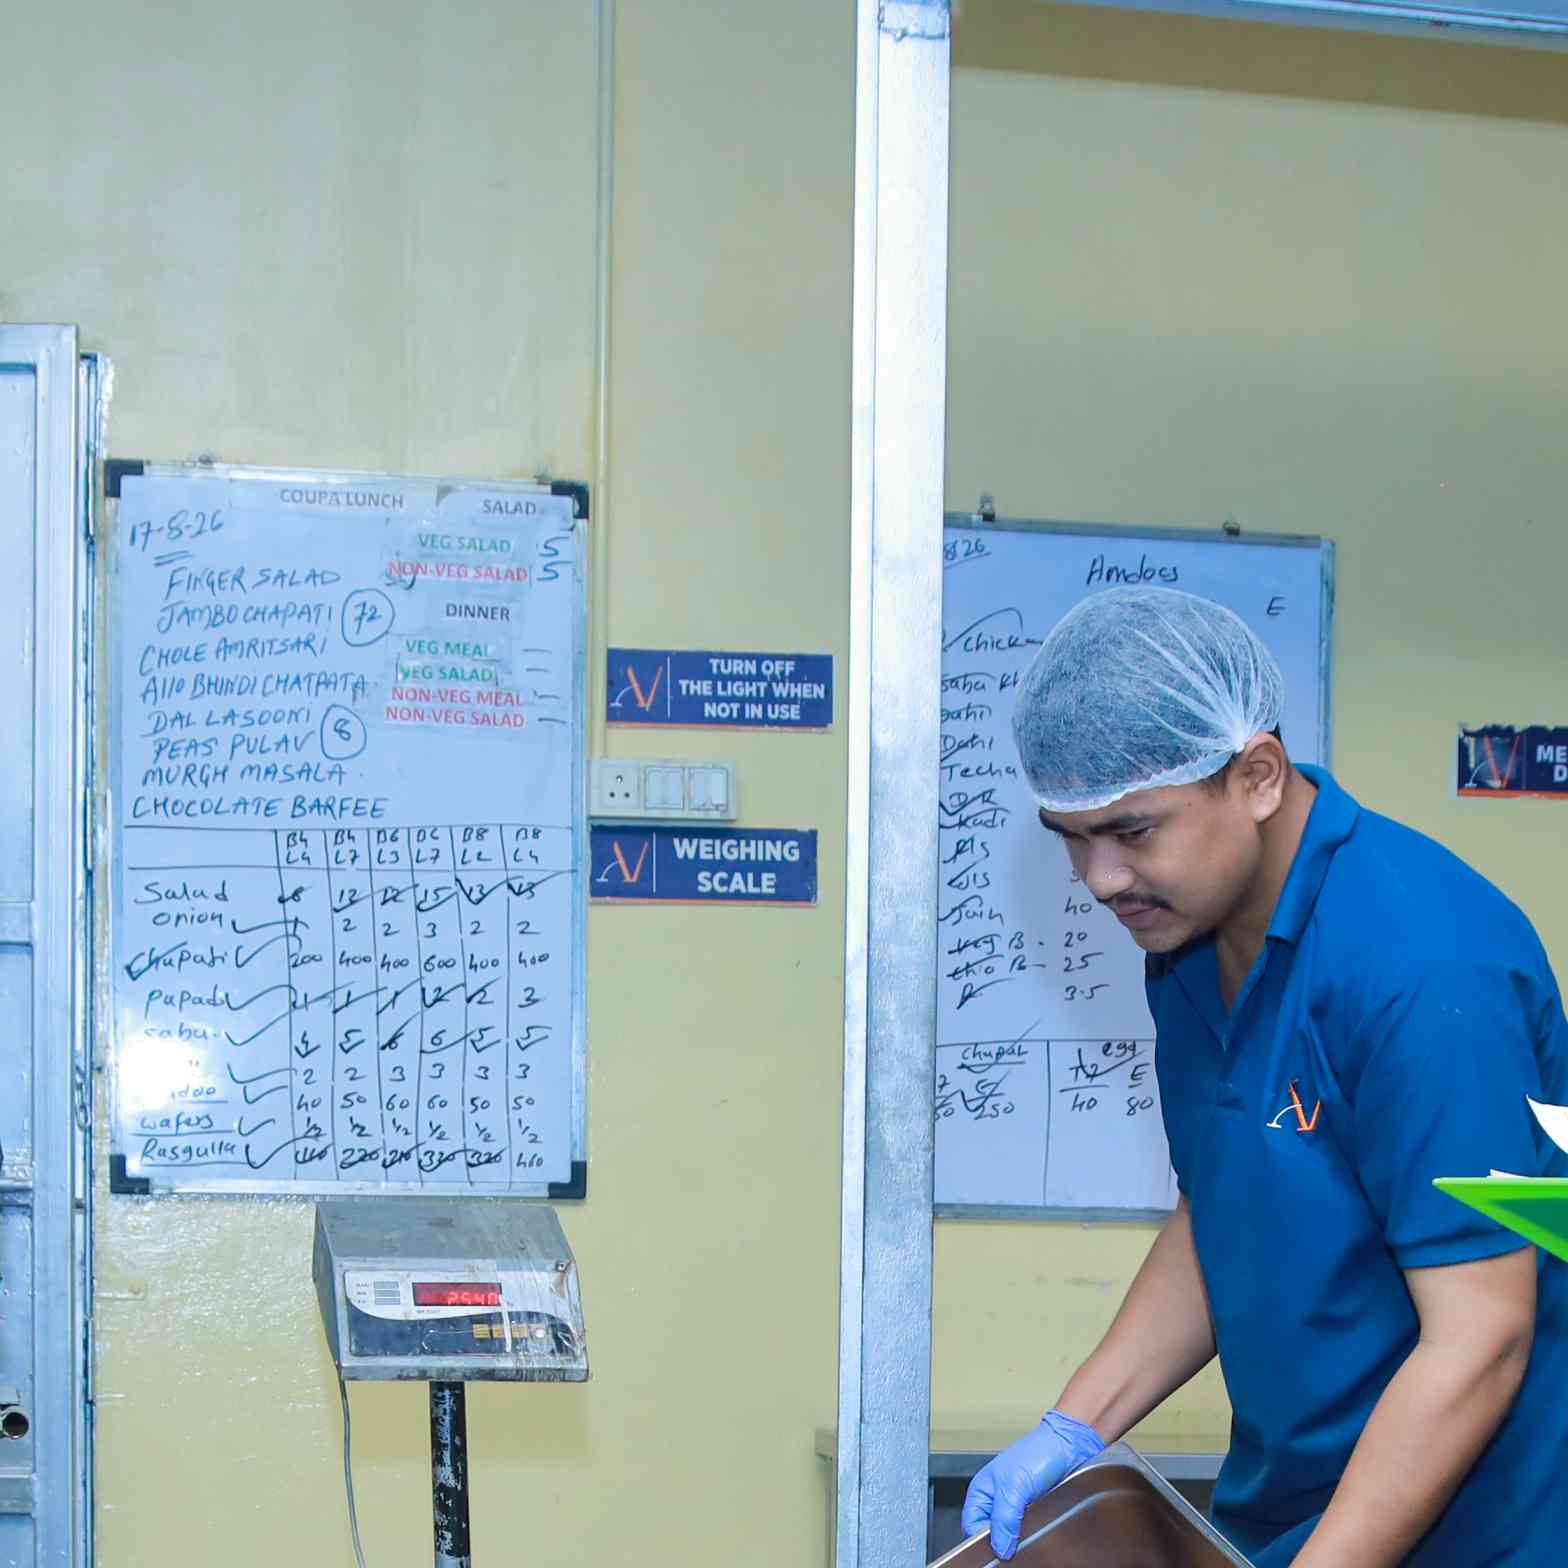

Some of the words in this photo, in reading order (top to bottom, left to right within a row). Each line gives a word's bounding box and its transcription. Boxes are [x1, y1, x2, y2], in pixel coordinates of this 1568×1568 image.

[280, 488, 340, 505] COUPA
[346, 491, 404, 509] LUNCH
[482, 500, 537, 516] SALAD
[417, 533, 451, 549] VEG
[458, 536, 512, 553] SALAD
[252, 567, 341, 591] SALAD
[388, 560, 468, 579] NON-VEG
[474, 564, 528, 582] SALAD
[445, 603, 510, 621] DINNER
[405, 639, 439, 655] VEG
[399, 665, 433, 681] VEG
[438, 666, 494, 682] SALAD
[709, 658, 757, 675] TURN
[761, 660, 795, 676] OFF
[391, 687, 471, 704] NON-VEG
[476, 690, 523, 707] MEAL
[679, 679, 712, 696] THE
[717, 680, 768, 698] LIGHT
[773, 682, 825, 699] WHEN
[386, 707, 465, 724] NON-VEG
[471, 710, 524, 727] SALAD
[704, 702, 740, 718] NOT
[745, 703, 763, 718] IN
[767, 704, 800, 719] USE
[141, 710, 196, 738] DAL
[240, 762, 346, 785] MASALA
[132, 795, 282, 819] CHOCOLATE
[290, 794, 388, 819] BARFEE
[673, 837, 800, 862] WEIGHING
[697, 871, 776, 893] SCALE
